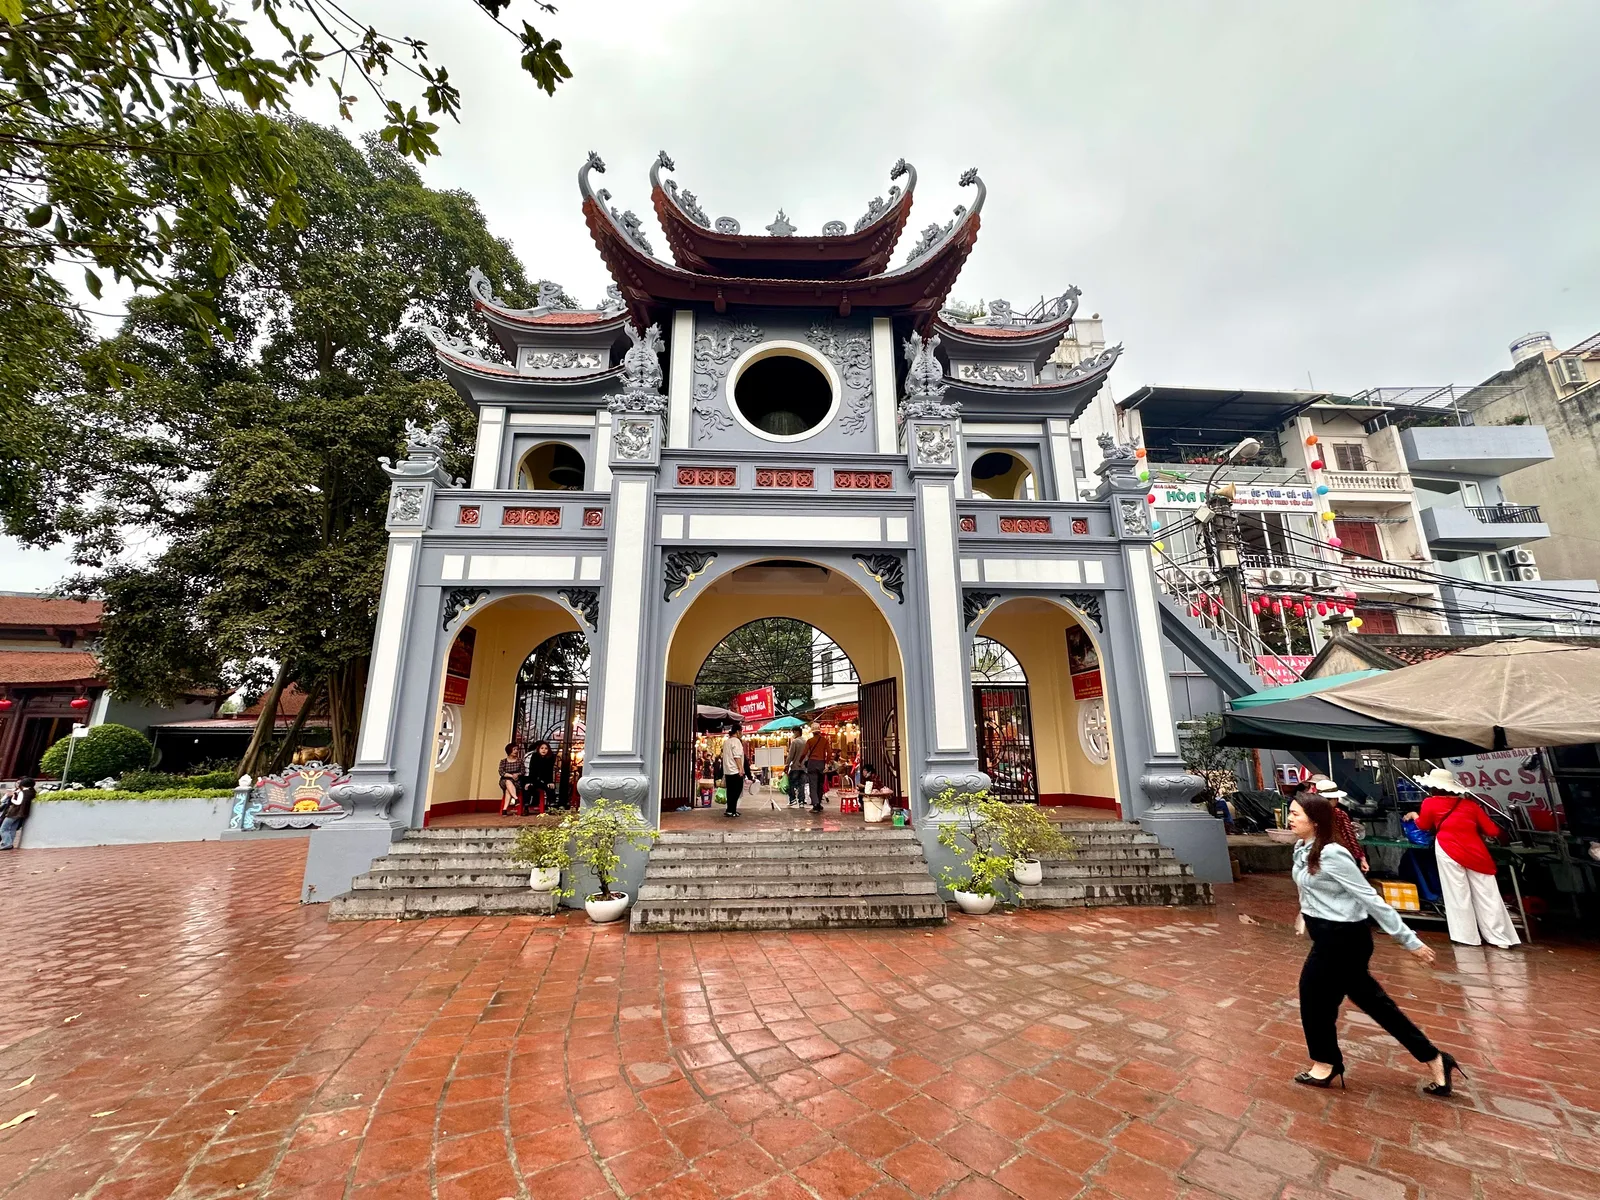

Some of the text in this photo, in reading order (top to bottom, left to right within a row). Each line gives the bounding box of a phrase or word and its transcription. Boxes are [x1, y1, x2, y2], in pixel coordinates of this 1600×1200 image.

[1166, 489, 1196, 502] HÒA
[756, 701, 766, 711] NGA
[1457, 765, 1512, 790] ĐẶC
